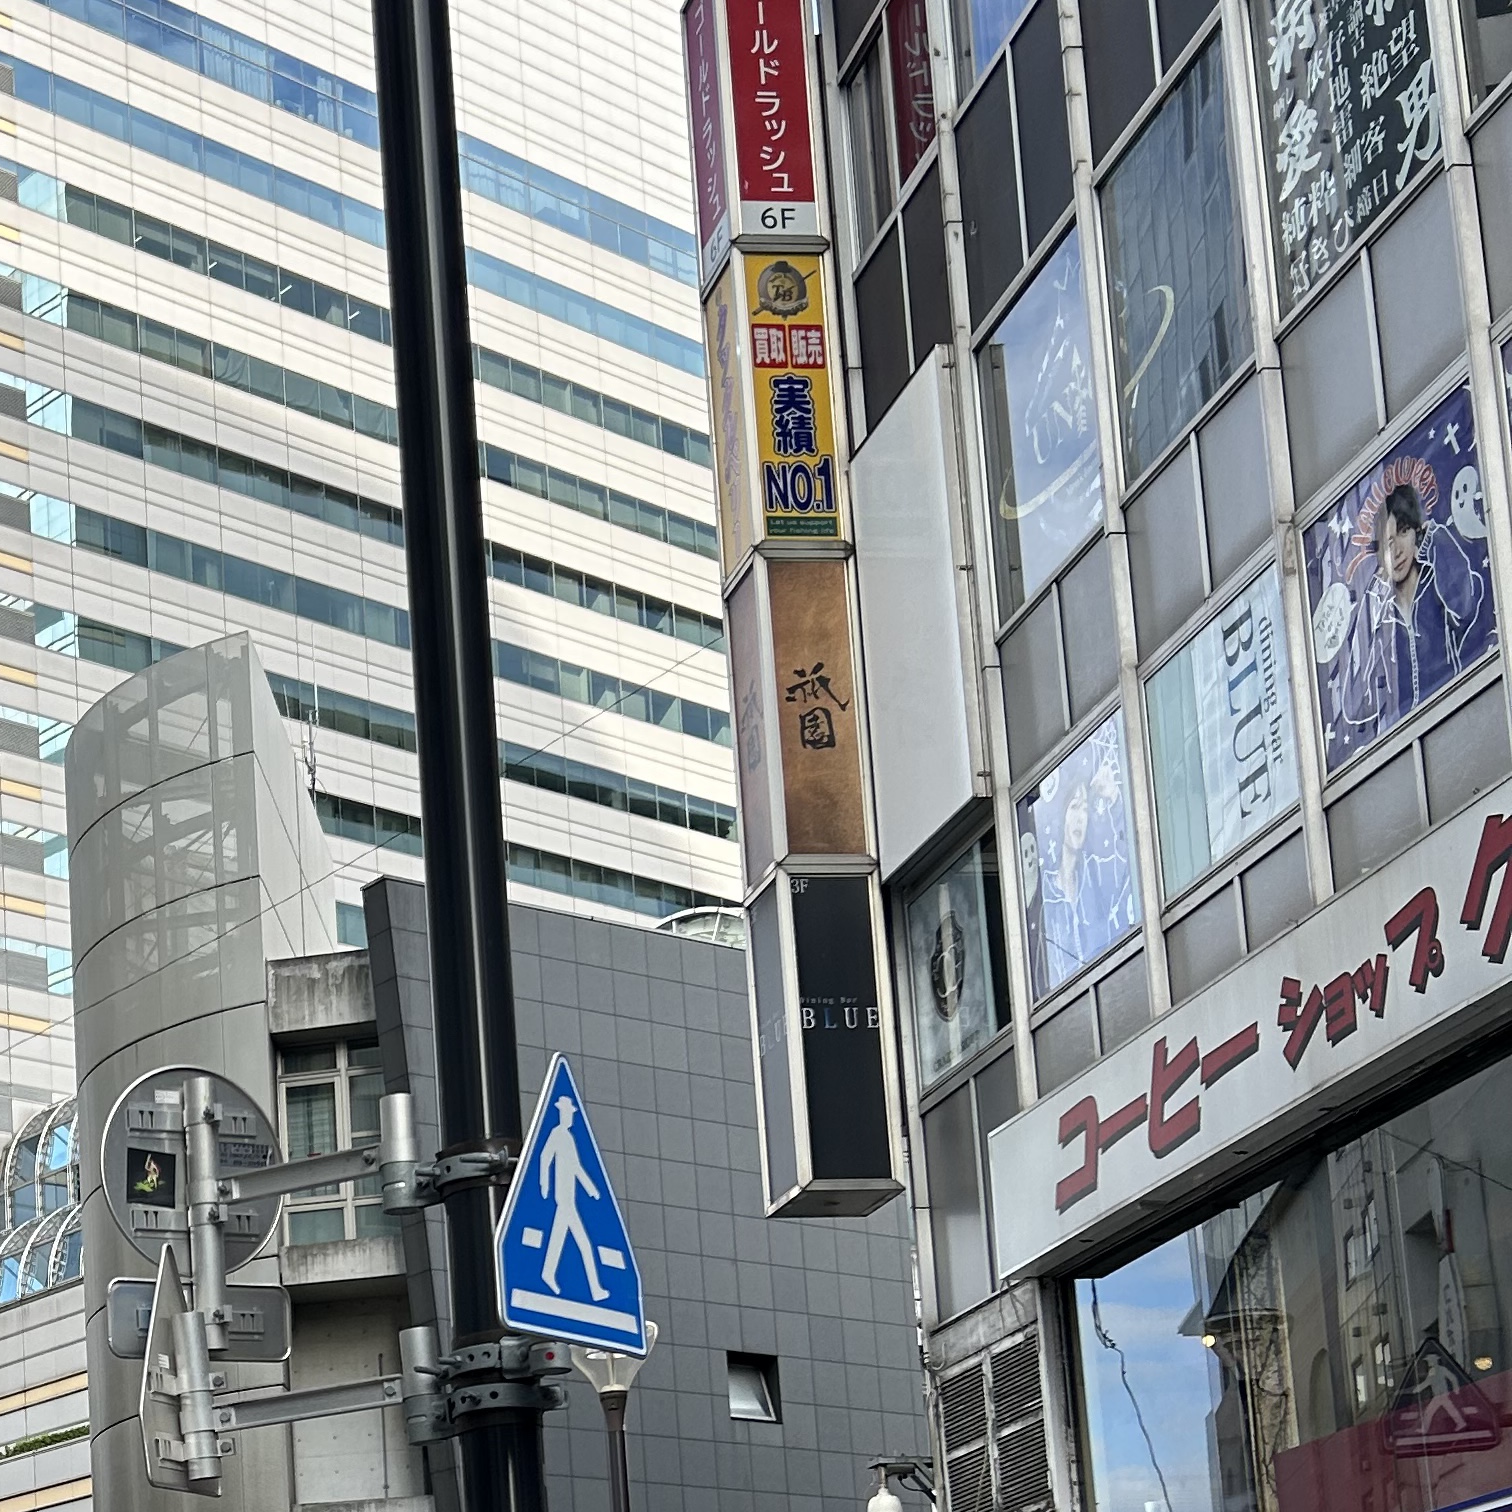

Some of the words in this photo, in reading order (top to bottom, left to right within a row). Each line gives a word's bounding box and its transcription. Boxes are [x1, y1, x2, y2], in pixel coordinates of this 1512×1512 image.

[761, 207, 796, 230] 6F
[753, 326, 787, 366] 買取
[791, 329, 824, 367] 販売
[771, 375, 817, 456] 実績
[764, 456, 836, 514] NO.1
[1222, 600, 1272, 819] BLUE
[1258, 616, 1278, 713] dining
[1270, 713, 1284, 765] bar
[791, 877, 809, 895] 3F
[801, 1006, 880, 1030] BLUE
